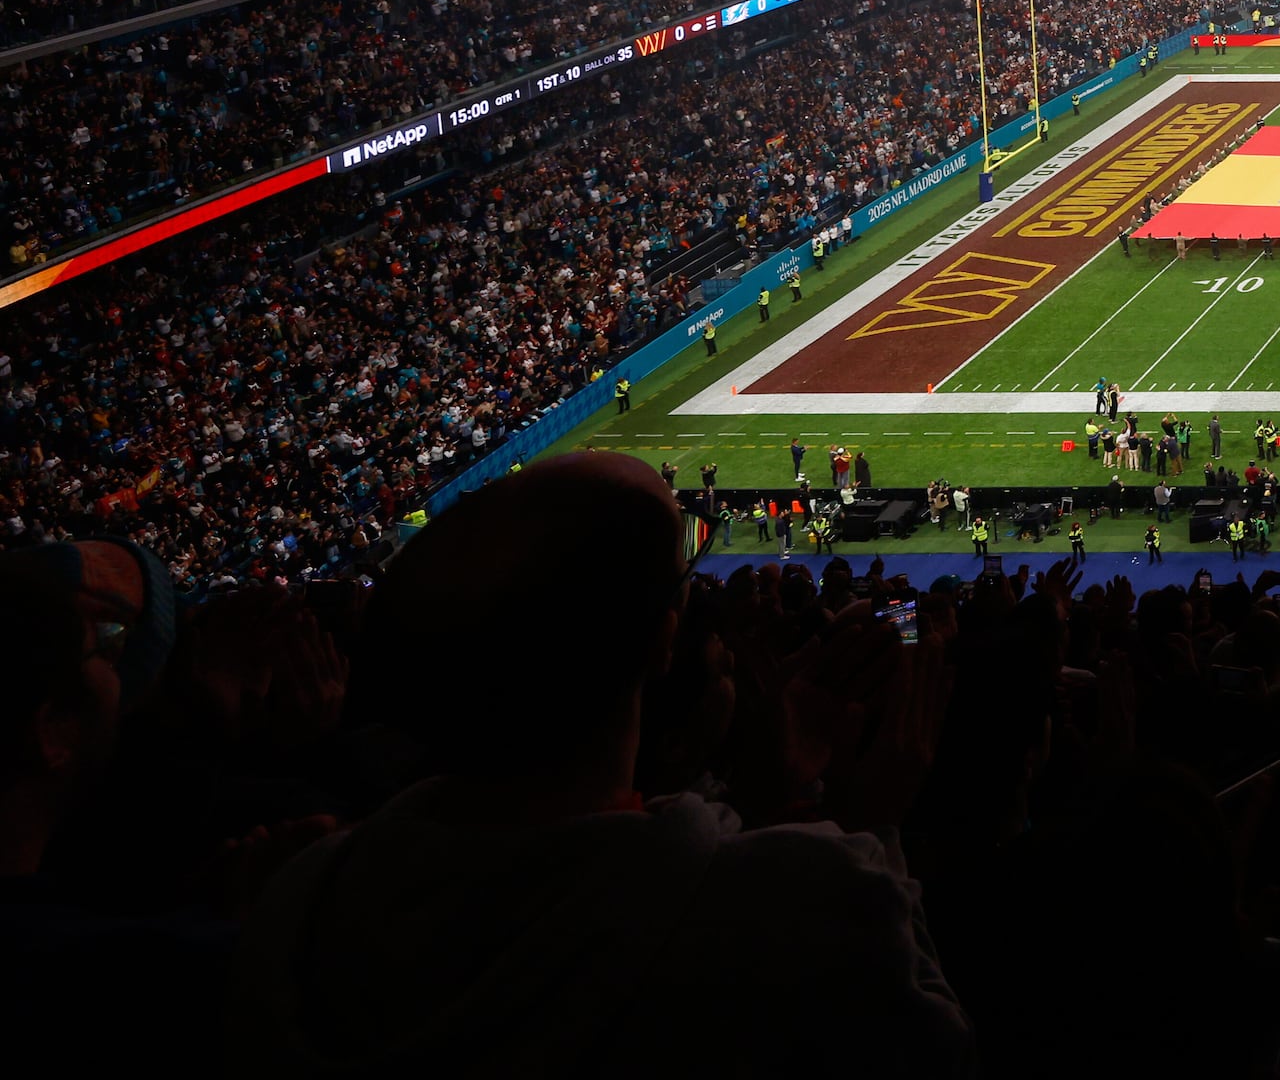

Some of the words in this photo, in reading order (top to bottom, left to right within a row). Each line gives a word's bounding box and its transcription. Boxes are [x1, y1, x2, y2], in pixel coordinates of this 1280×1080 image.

[364, 124, 427, 159] NetApp
[450, 100, 490, 127] 15:00
[495, 92, 512, 106] QTR
[537, 73, 559, 92] 1ST
[565, 66, 581, 82] 10
[585, 59, 603, 72] BALL
[604, 53, 615, 64] ON
[617, 46, 633, 62] 35
[674, 26, 685, 41] 0
[868, 203, 891, 222] 2025
[891, 192, 909, 212] NFL
[908, 168, 942, 201] MADRID
[943, 154, 967, 178] GAME
[898, 254, 923, 267] IT
[926, 207, 1000, 247] TAKES
[998, 183, 1039, 202] ALL
[1032, 163, 1062, 177] OF
[1058, 146, 1089, 159] US
[1017, 102, 1241, 239] COMMANDERS
[1206, 276, 1265, 294] 10
